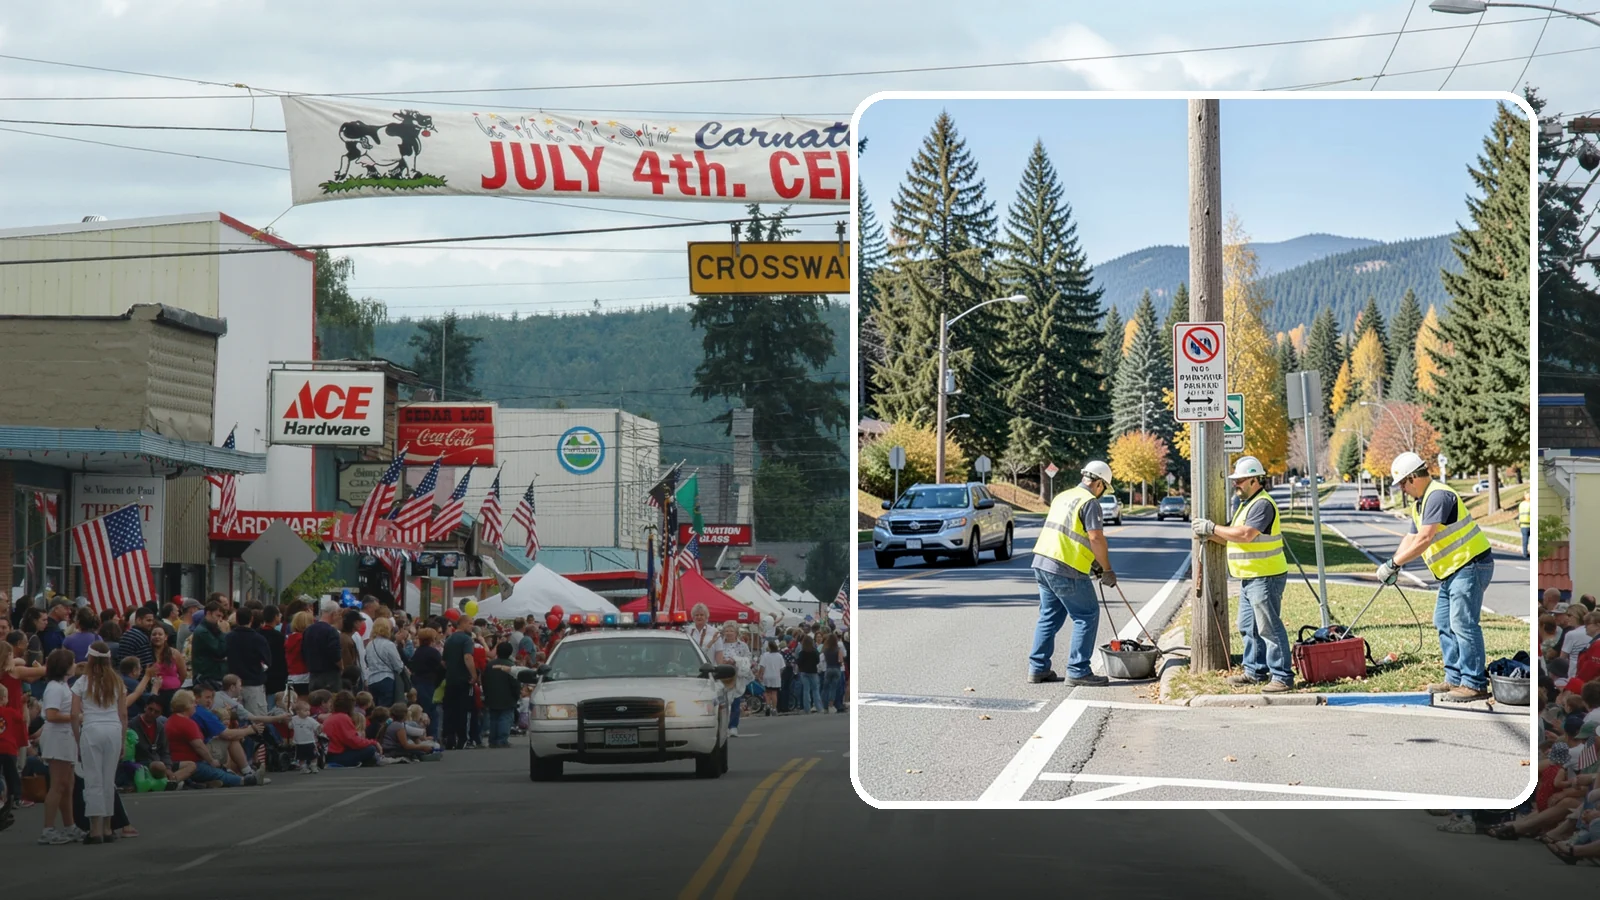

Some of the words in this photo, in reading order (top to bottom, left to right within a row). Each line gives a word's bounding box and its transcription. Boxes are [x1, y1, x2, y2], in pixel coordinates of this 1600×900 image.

[481, 141, 605, 192] JULY
[632, 150, 746, 197] 4th.
[697, 255, 850, 280] CROSSWA
[283, 380, 373, 419] ACE
[406, 410, 452, 422] CEDAR
[284, 421, 370, 436] Hardware
[416, 428, 476, 447] Coca-Cola
[353, 467, 384, 480] Simpl
[95, 485, 124, 495] Vincent
[126, 486, 135, 495] de
[137, 486, 155, 495] Paul
[81, 503, 154, 522] THT
[213, 516, 331, 536] HARDARE
[688, 526, 741, 535] CRNATION
[699, 535, 730, 543] GLASS
